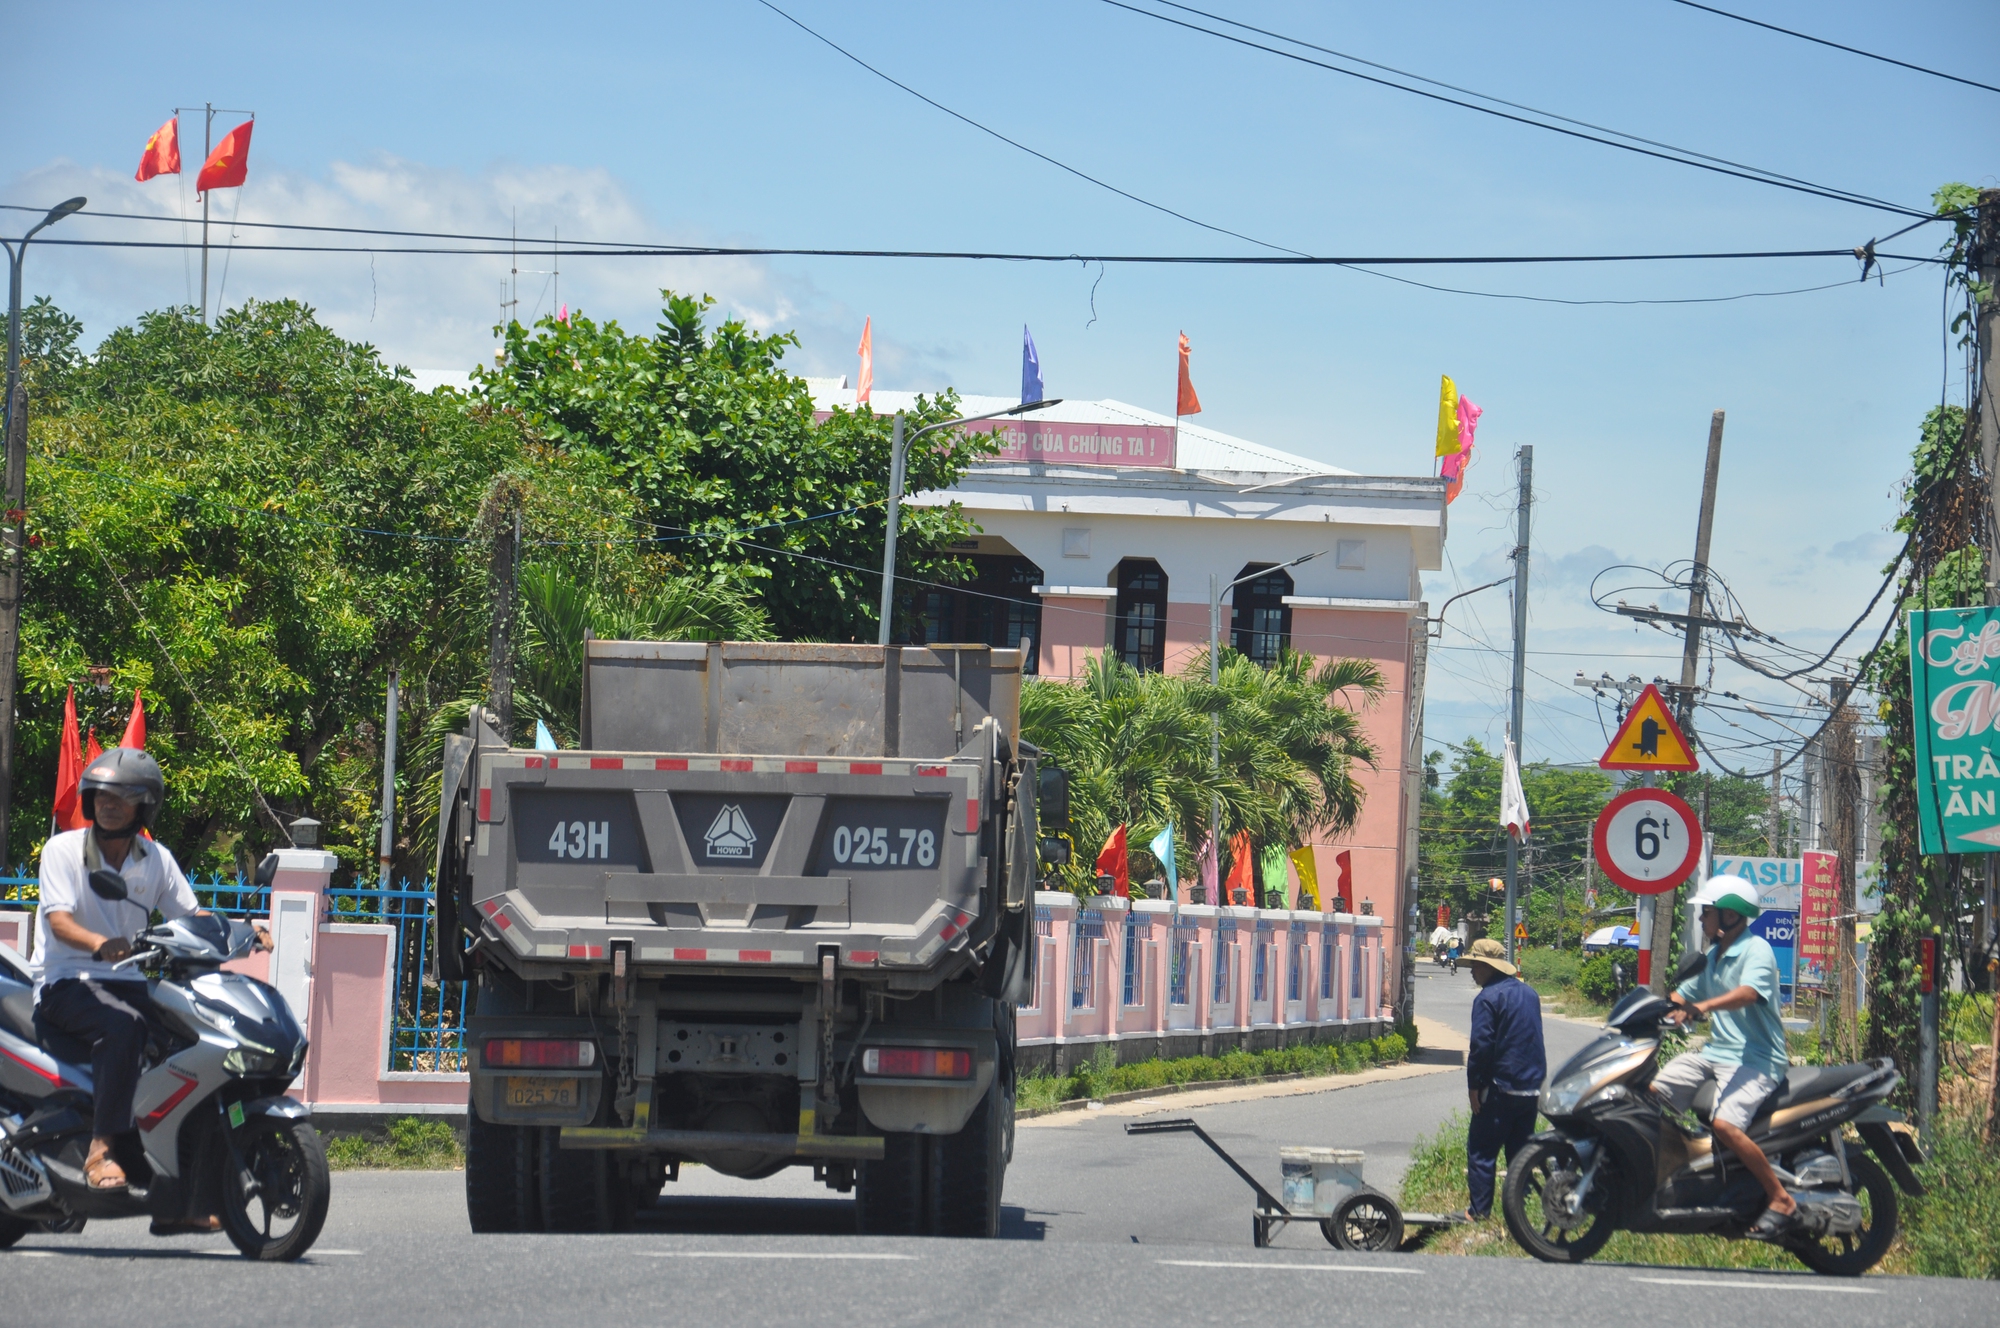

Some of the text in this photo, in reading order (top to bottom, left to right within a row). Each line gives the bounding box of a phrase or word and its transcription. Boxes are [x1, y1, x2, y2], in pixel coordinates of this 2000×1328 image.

[1032, 427, 1065, 453] CỦA
[1068, 431, 1123, 455] CHÚNG
[1127, 437, 1144, 456] TA
[1932, 745, 2000, 780] TRÀ
[1944, 785, 1996, 817] ĂN
[548, 821, 609, 859] 43H
[717, 846, 742, 855] HOWO
[833, 825, 935, 867] 025.78
